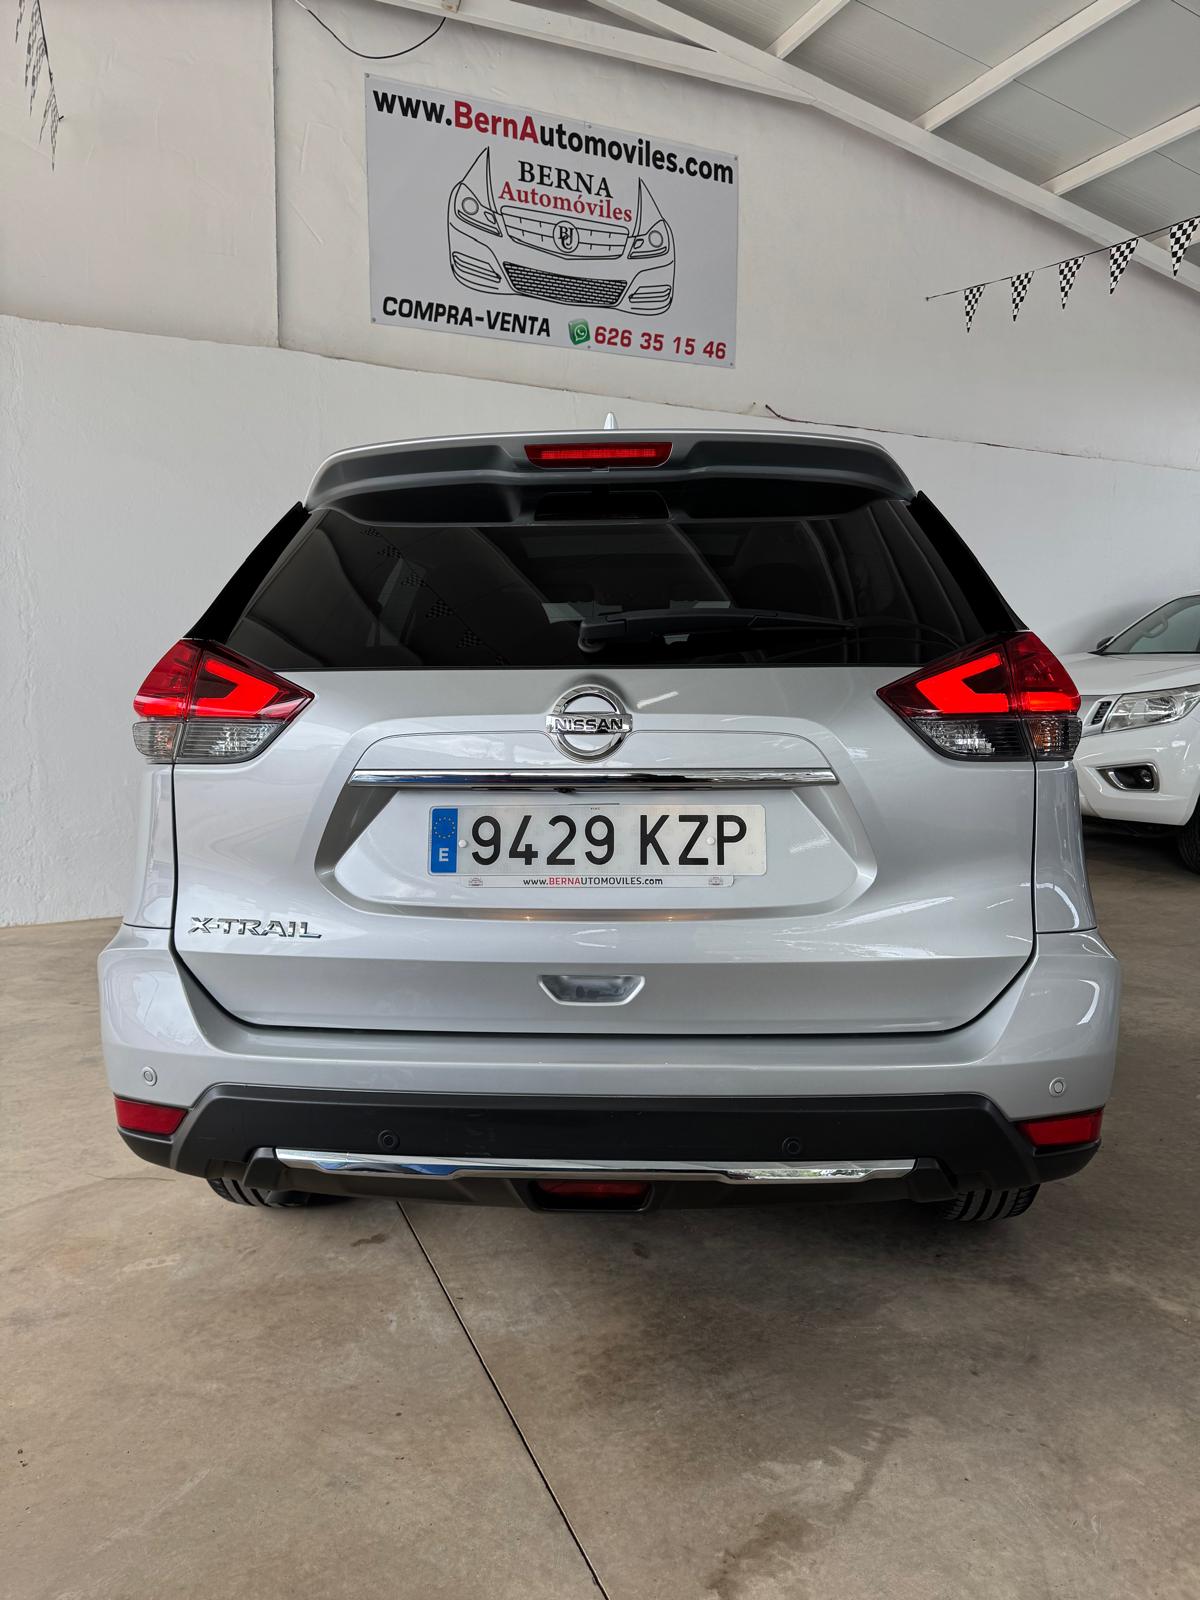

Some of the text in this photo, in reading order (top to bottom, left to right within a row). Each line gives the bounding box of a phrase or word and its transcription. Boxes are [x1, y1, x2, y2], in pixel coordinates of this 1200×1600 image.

[373, 90, 734, 184] www.BernAutomoviles.com
[518, 160, 613, 199] BERNA
[499, 181, 632, 222] Automóviles
[383, 296, 551, 337] COMPRA-VENTA
[594, 326, 726, 359] 626 35 15 46
[554, 718, 623, 730] NISSAN
[438, 848, 449, 862] E
[471, 815, 747, 866] 9429 KZP
[523, 876, 663, 886] www.BERNAUTOMOVILES.com
[188, 917, 322, 939] X-TRAIL
